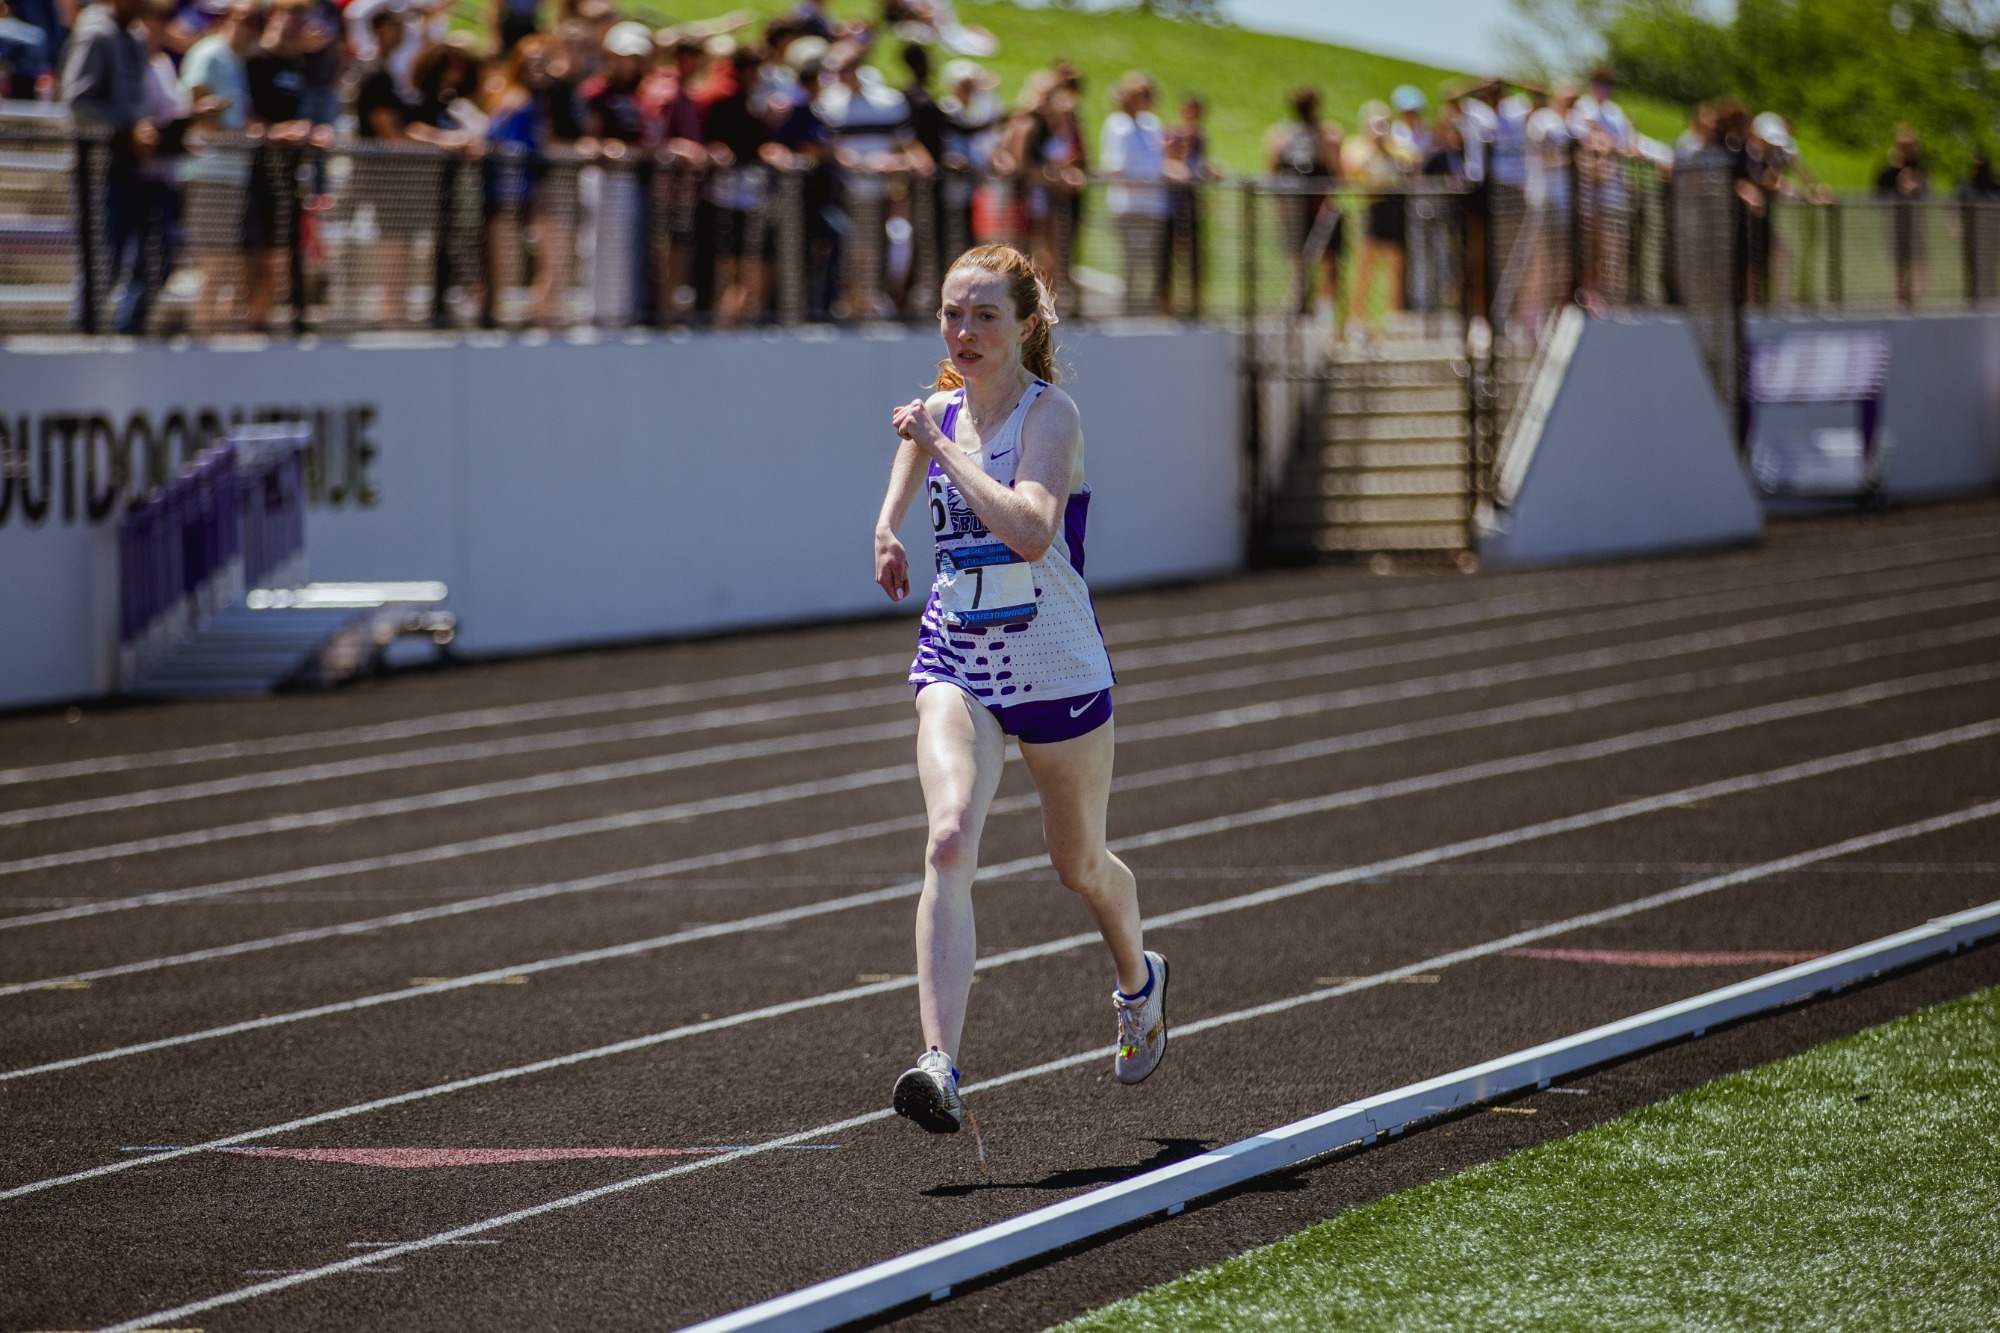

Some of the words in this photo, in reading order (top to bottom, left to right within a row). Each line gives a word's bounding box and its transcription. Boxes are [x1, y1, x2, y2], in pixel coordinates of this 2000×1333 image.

[0, 410, 224, 528] UTDOO
[930, 480, 946, 532] 6
[950, 515, 989, 532] SBU
[964, 567, 983, 609] 7
[980, 612, 994, 620] FIELD
[994, 606, 1035, 619] CHAMPIONSHIPS
